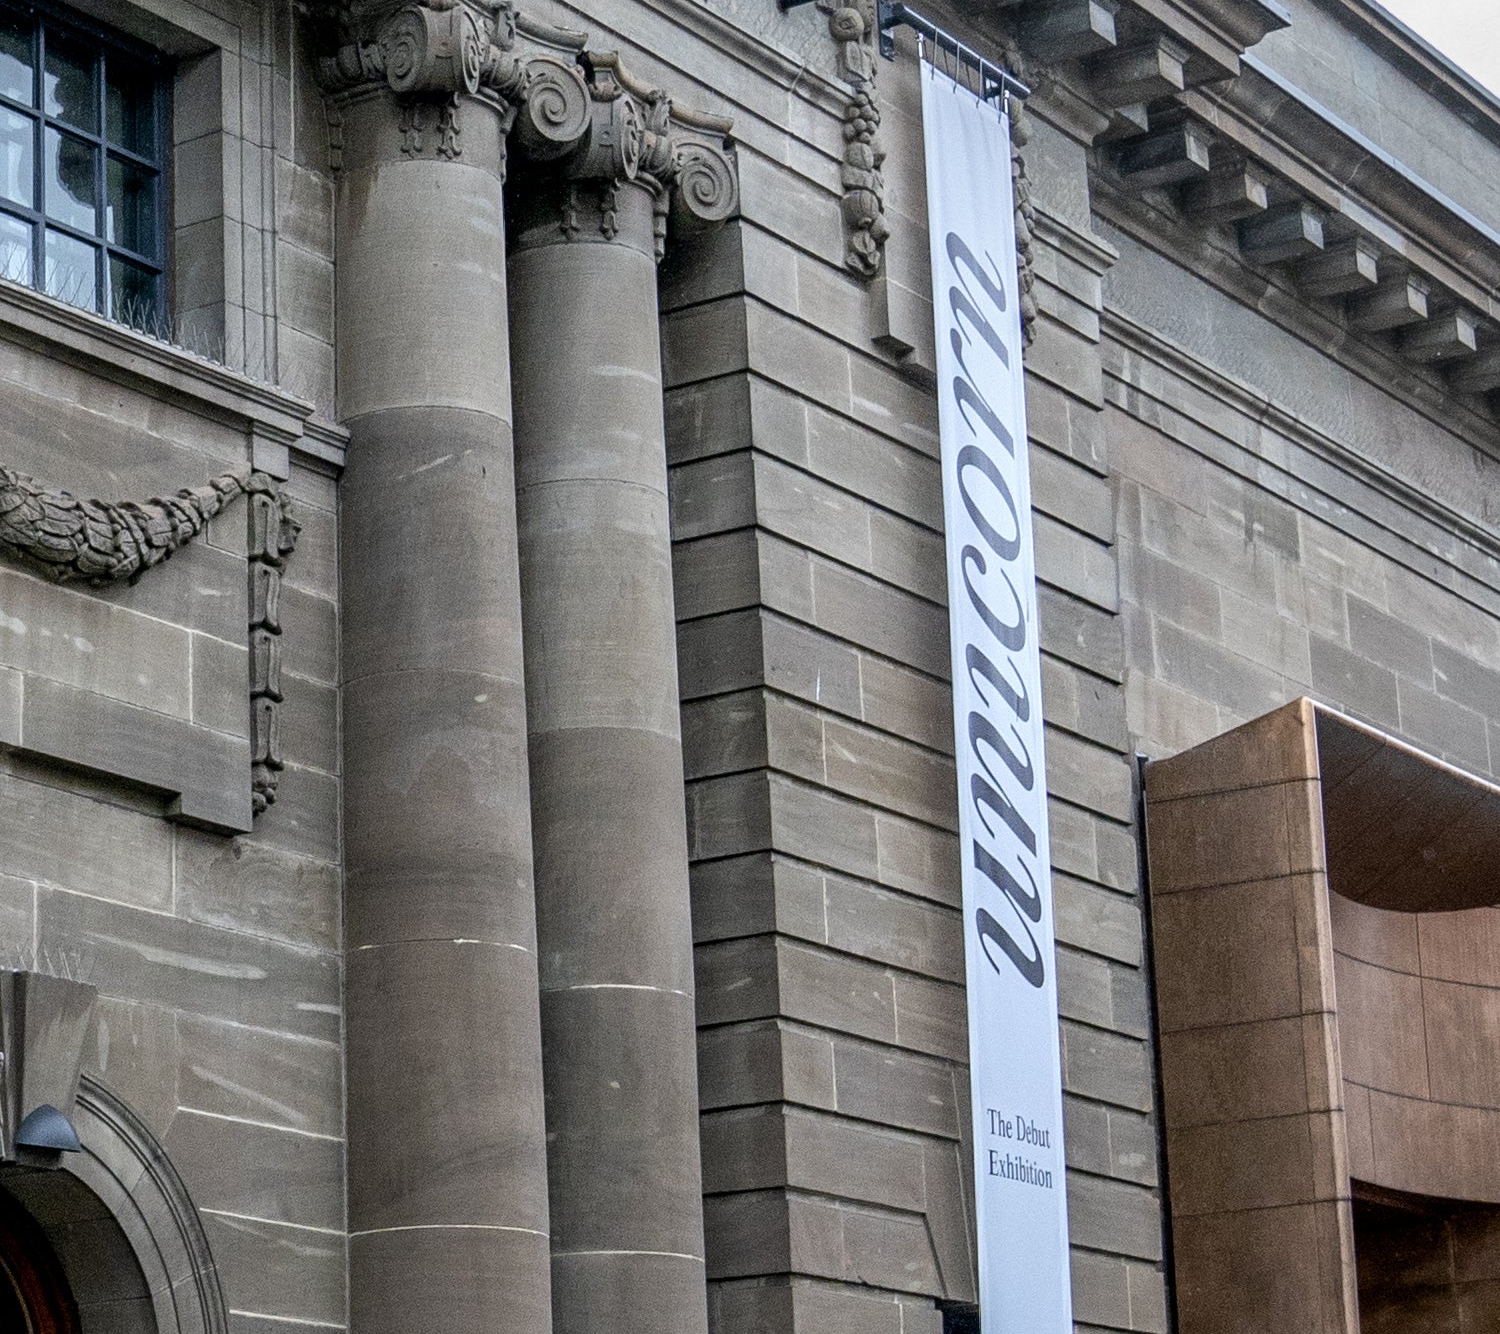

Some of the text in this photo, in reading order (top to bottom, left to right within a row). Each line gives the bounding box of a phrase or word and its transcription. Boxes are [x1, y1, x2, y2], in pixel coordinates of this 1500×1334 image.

[987, 1108, 1051, 1149] The Debut
[987, 1148, 1053, 1189] Exhibition
